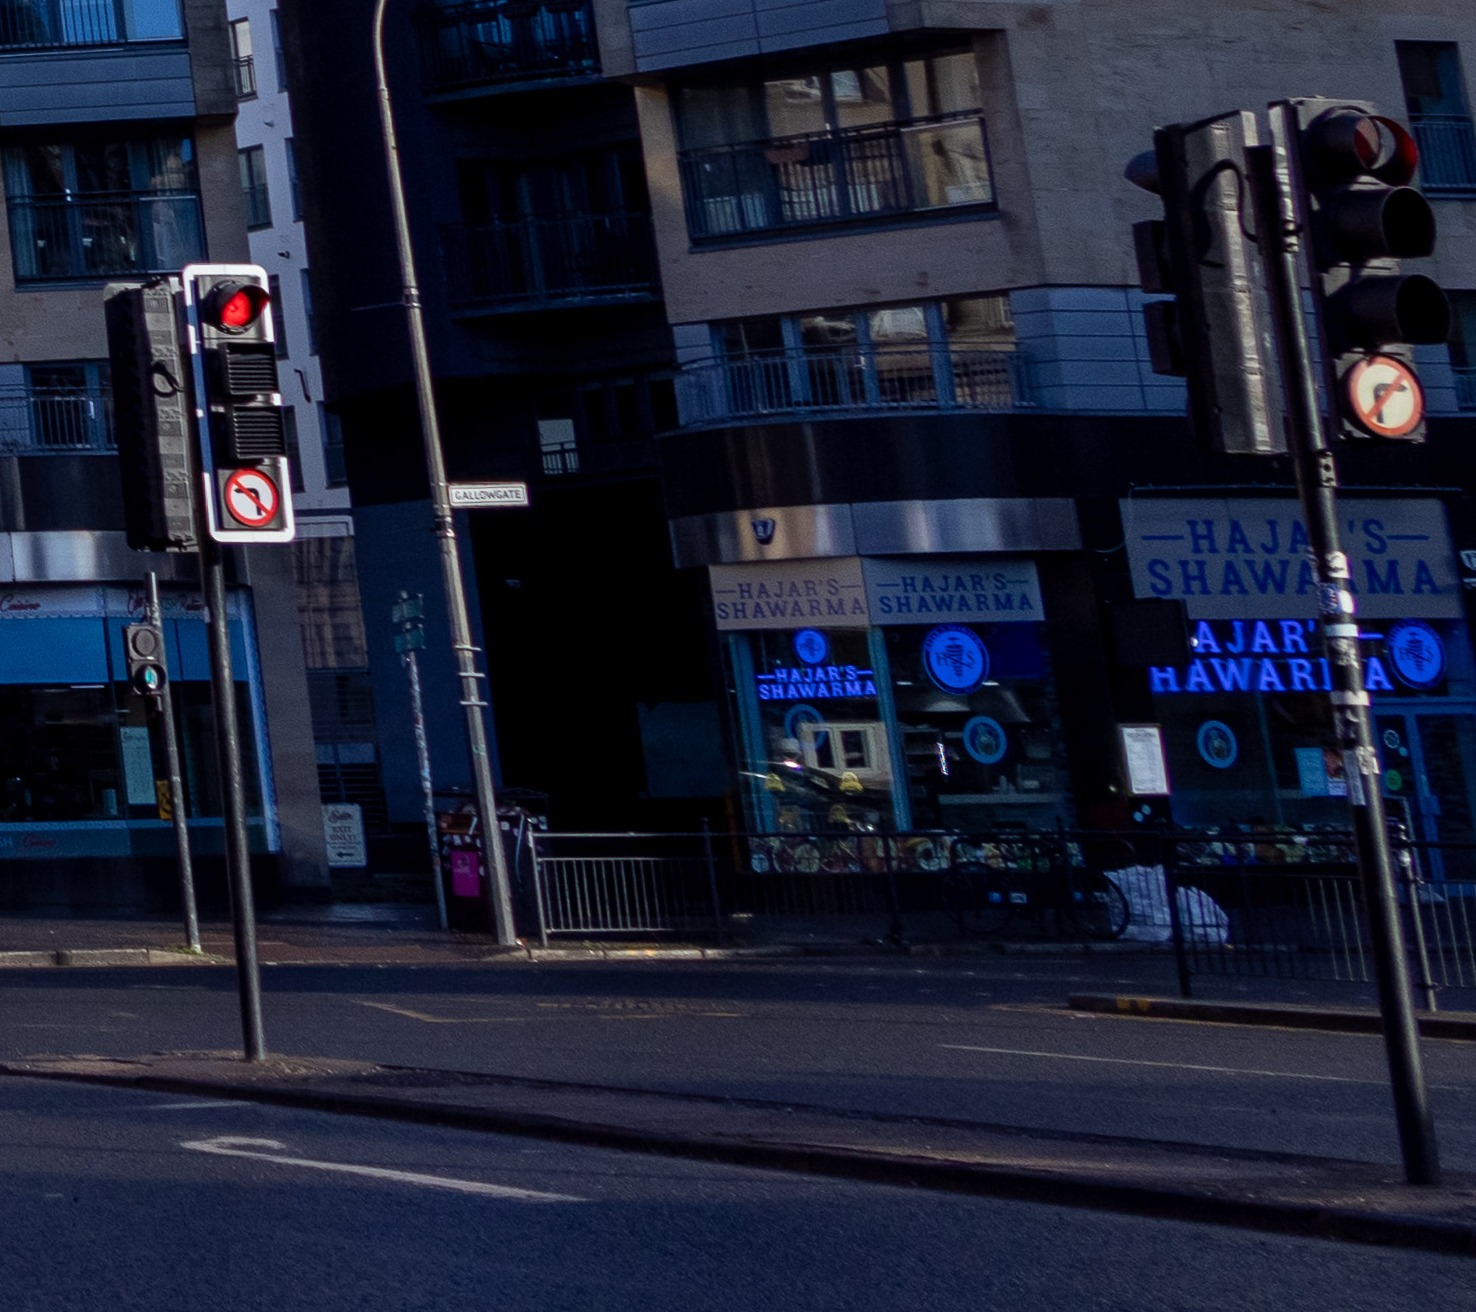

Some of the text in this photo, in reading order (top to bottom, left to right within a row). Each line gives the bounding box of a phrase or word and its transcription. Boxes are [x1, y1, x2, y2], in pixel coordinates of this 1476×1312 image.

[455, 490, 521, 500] GALLOWGATE
[1187, 519, 1388, 554] HAJA'S
[901, 574, 1007, 593] HAJAR'S
[1147, 559, 1443, 595] SHAWAMA
[739, 578, 840, 599] HAJAR'S
[717, 598, 866, 620] SHAWARMA
[879, 593, 1033, 614] SHAWARMA
[775, 665, 858, 684] HAJAR'S
[758, 680, 877, 701] SHAWARMA
